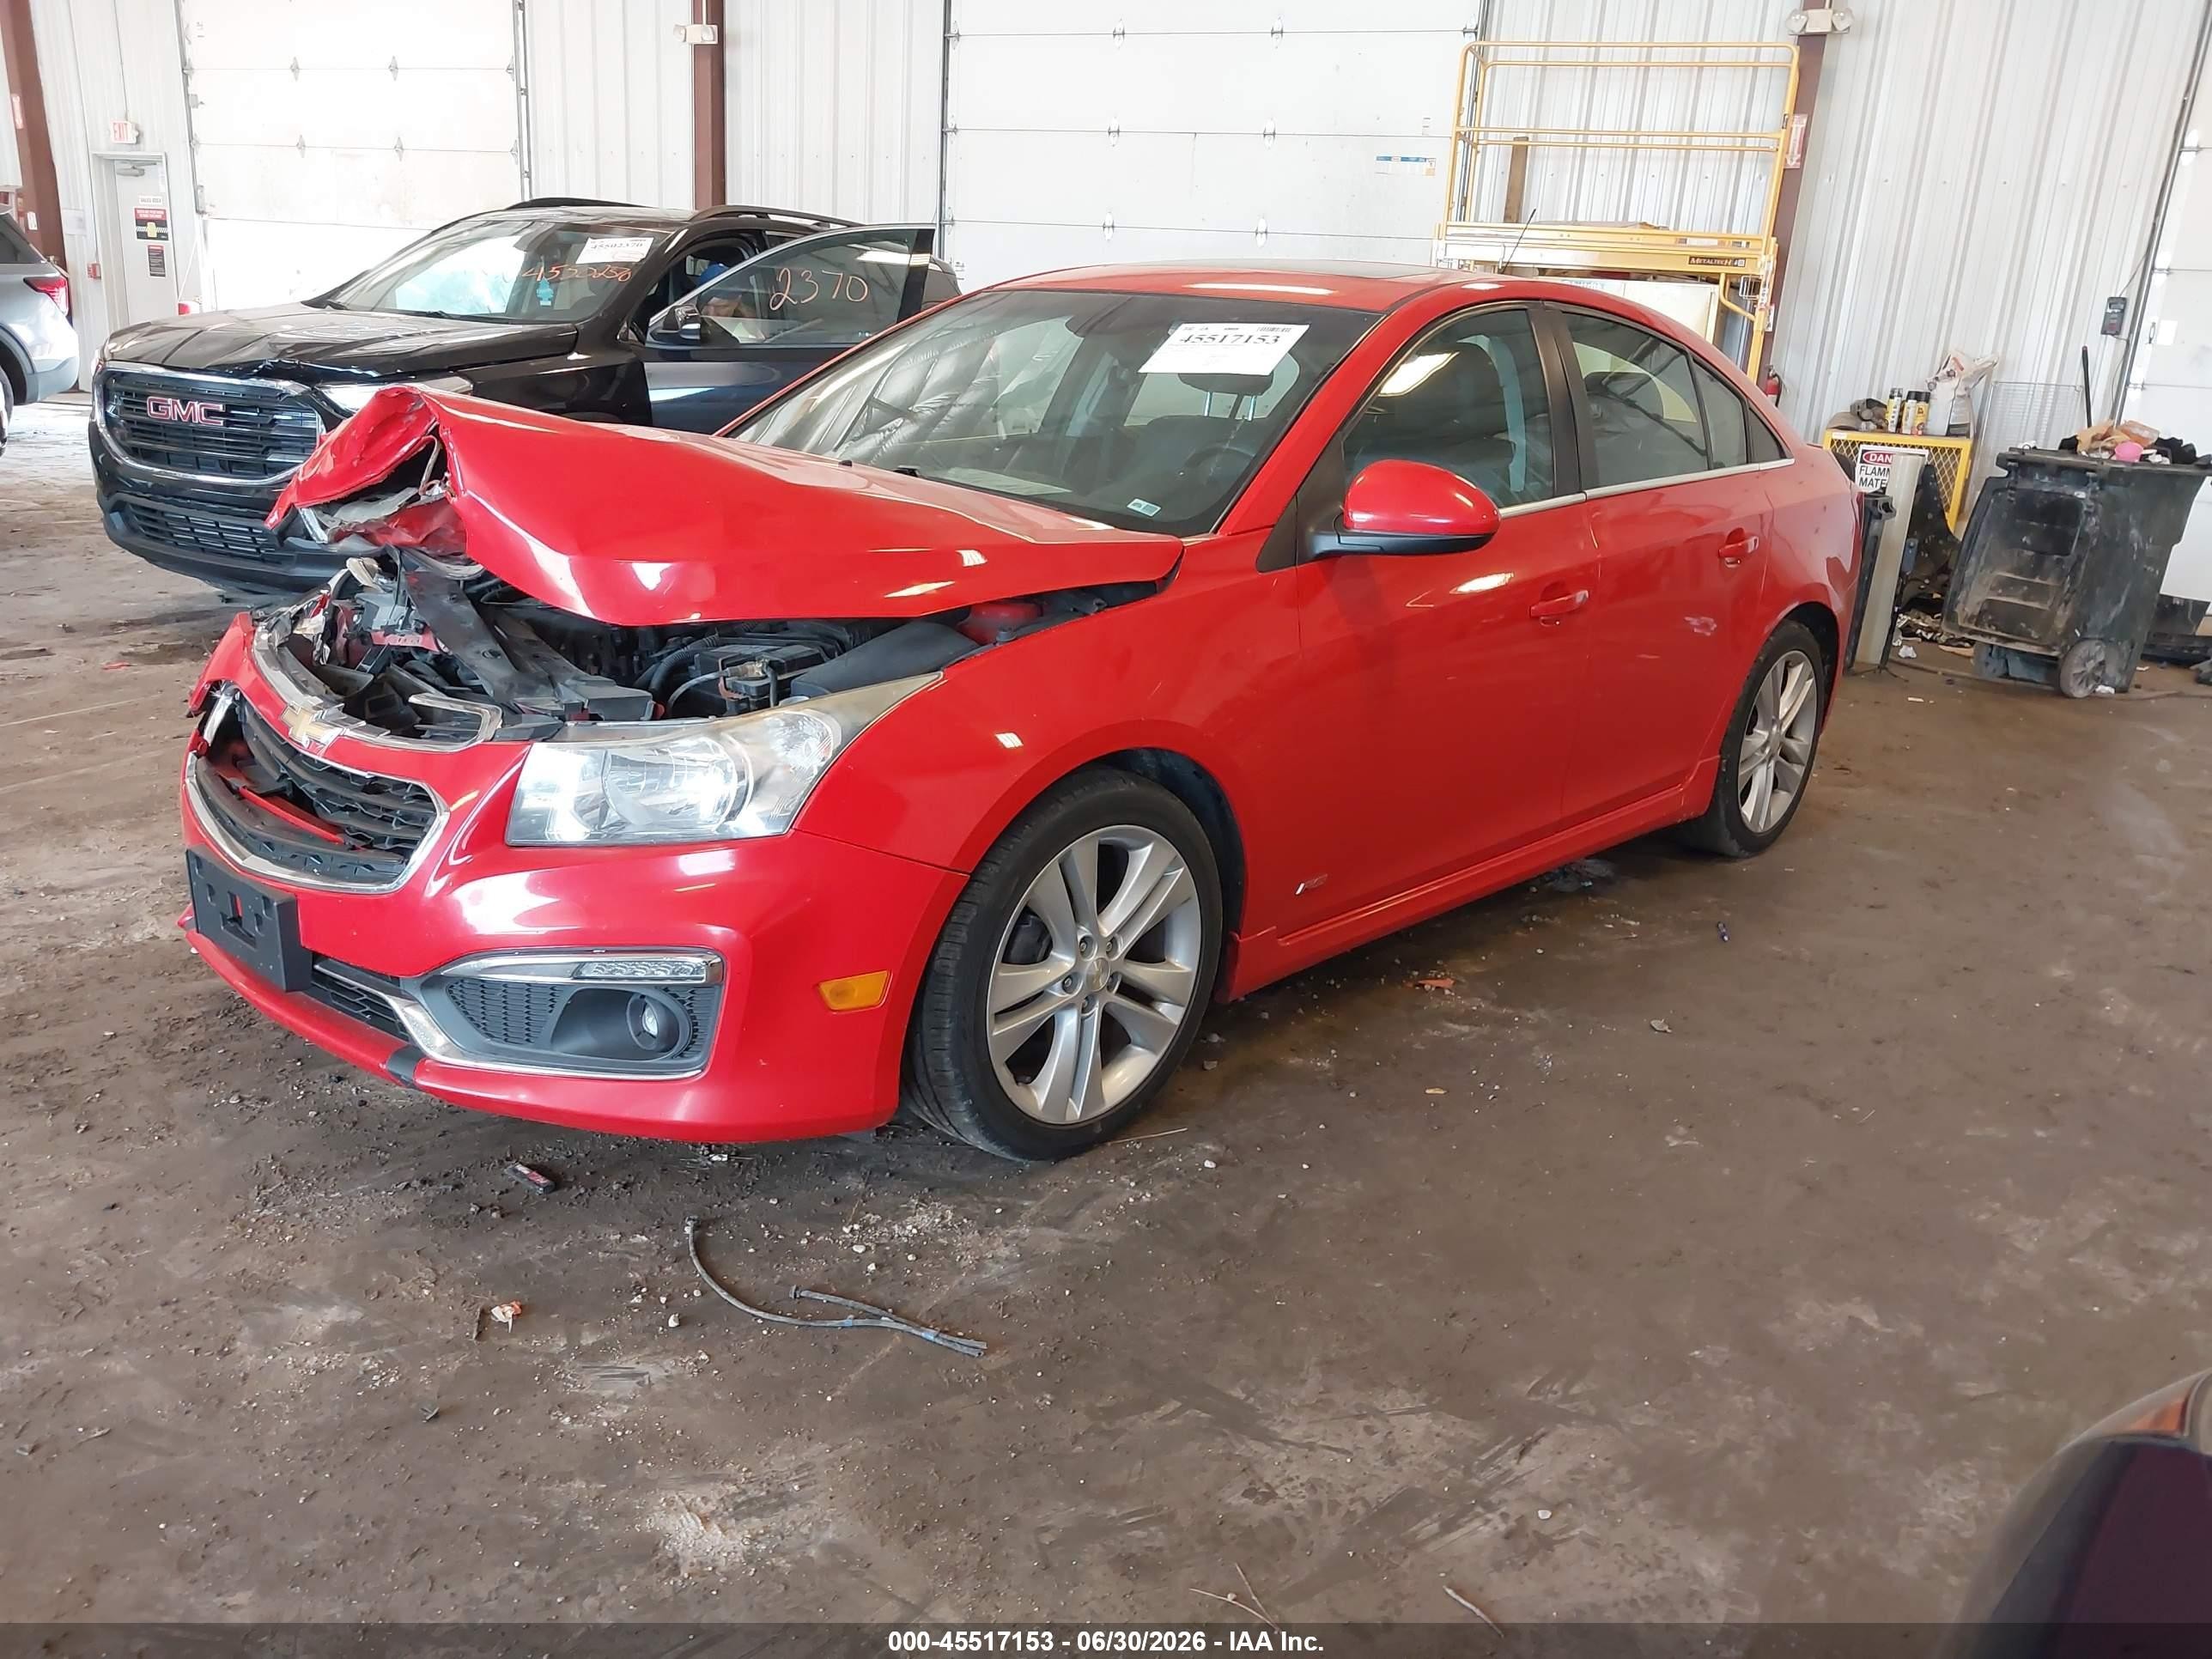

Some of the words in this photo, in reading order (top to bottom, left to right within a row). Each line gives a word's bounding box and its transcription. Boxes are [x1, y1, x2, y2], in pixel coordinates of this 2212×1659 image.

[769, 267, 868, 311] 2370
[1179, 333, 1281, 344] 45517153
[147, 396, 224, 426] GMC
